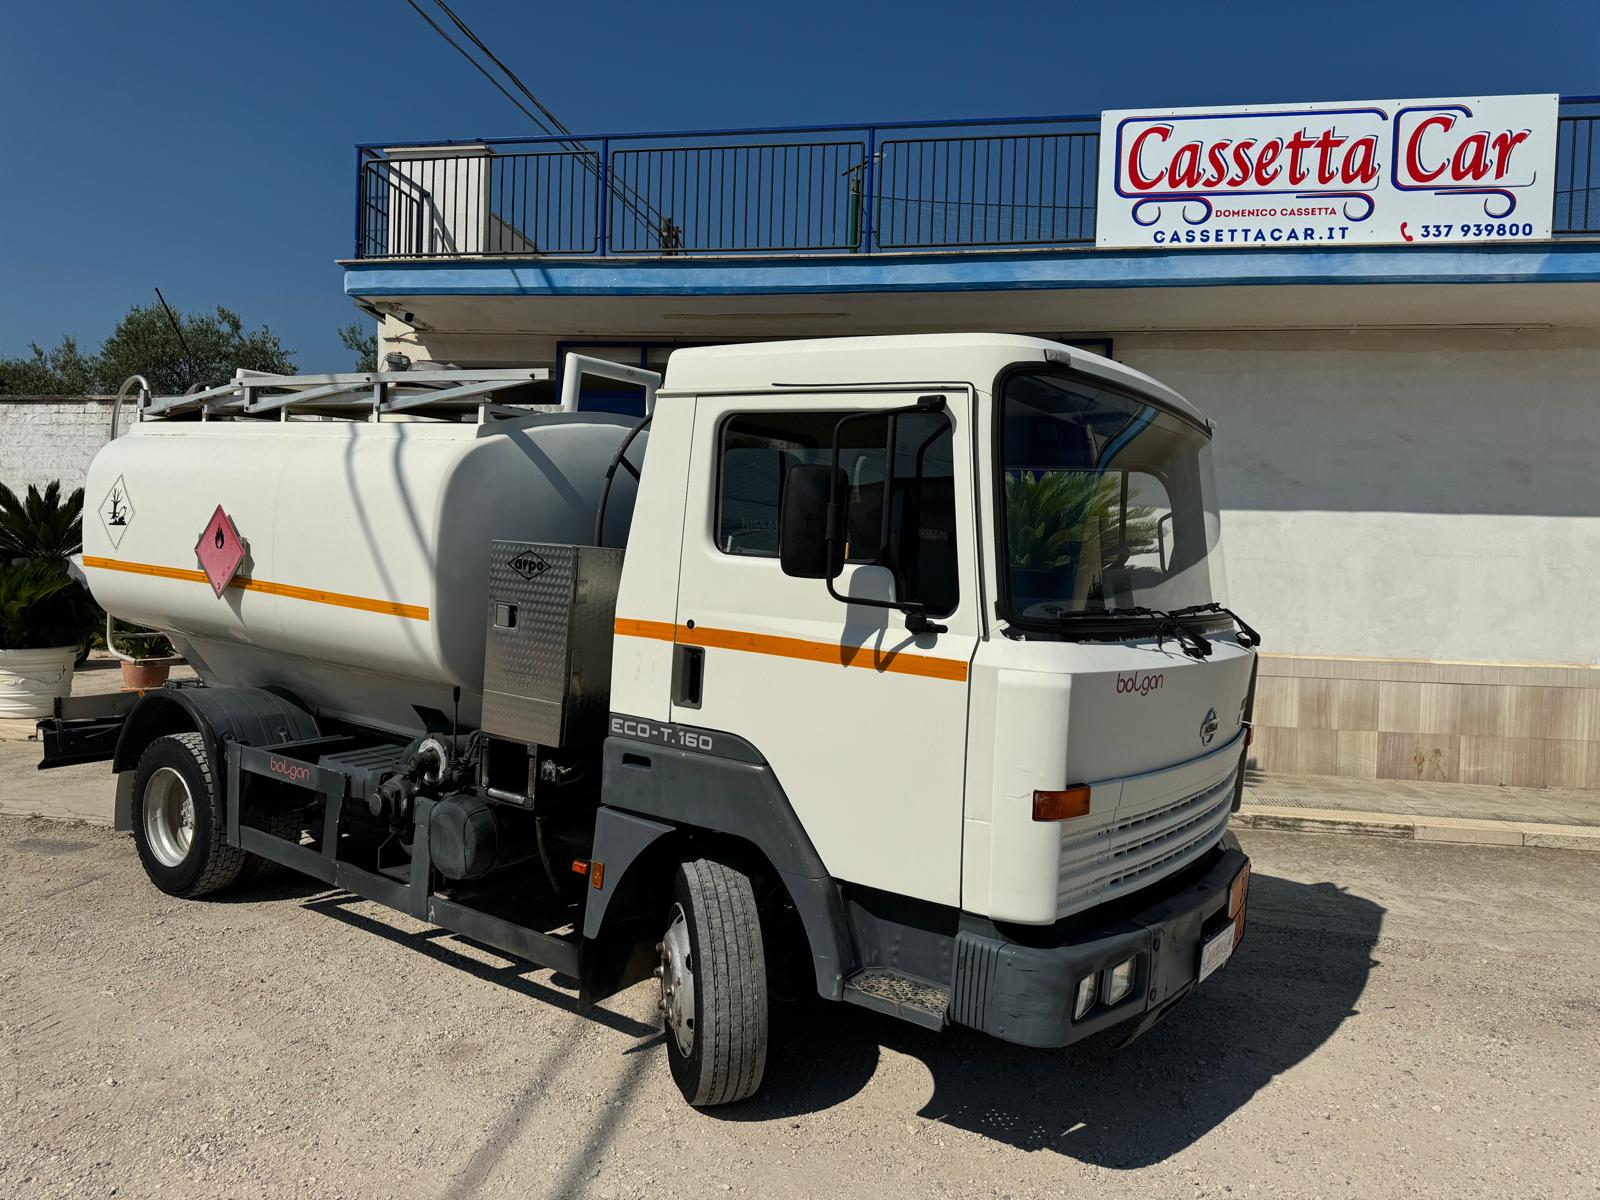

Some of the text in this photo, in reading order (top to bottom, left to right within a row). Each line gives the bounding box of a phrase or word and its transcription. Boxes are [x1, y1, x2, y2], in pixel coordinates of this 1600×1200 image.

[1128, 113, 1532, 190] Cassetta Car
[1215, 207, 1337, 218] DOMENICO CASSETTA
[1153, 227, 1349, 243] CASSETTACAR.IT
[1421, 223, 1533, 238] 337 939800
[514, 559, 544, 574] arpo
[1117, 671, 1163, 697] bolgan
[270, 755, 310, 781] bolgan
